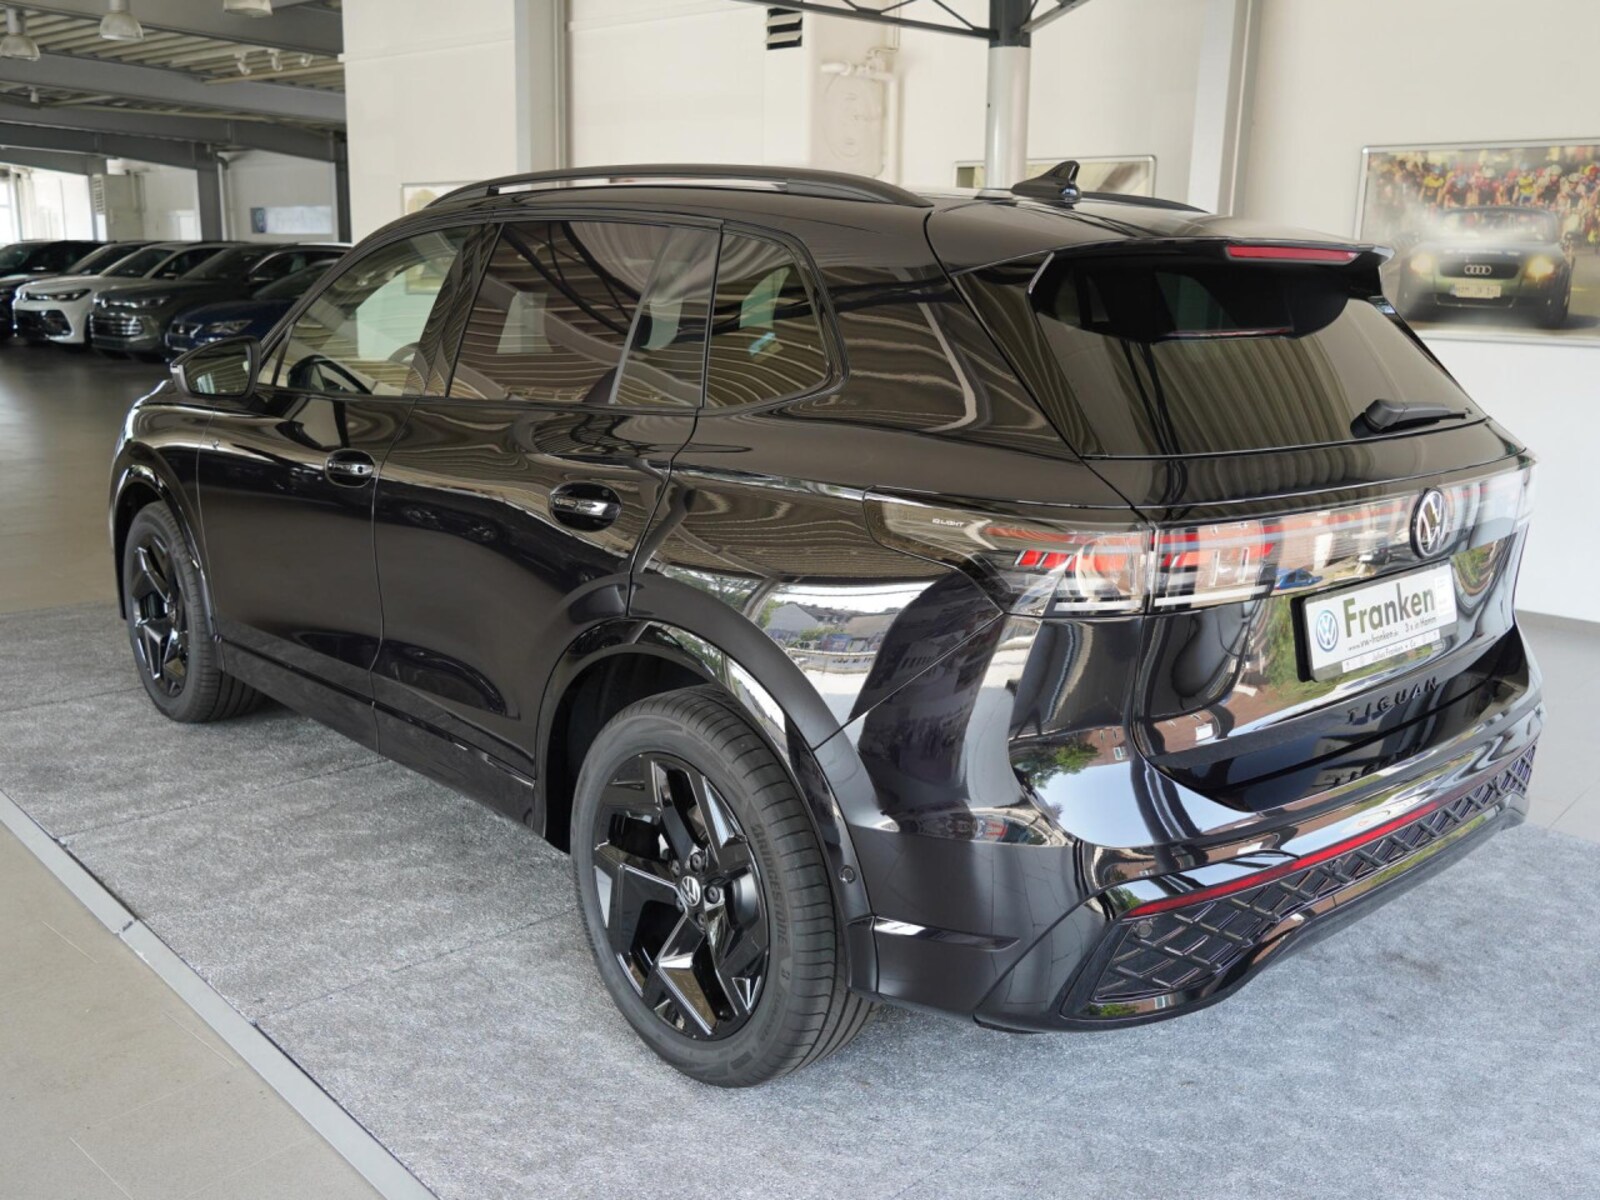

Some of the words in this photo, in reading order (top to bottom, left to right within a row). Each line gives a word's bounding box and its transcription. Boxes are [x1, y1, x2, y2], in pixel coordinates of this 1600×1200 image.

[1343, 582, 1435, 638] Franken
[1347, 676, 1436, 722] TIGUAN
[750, 824, 788, 944] BRIDGESTONE
